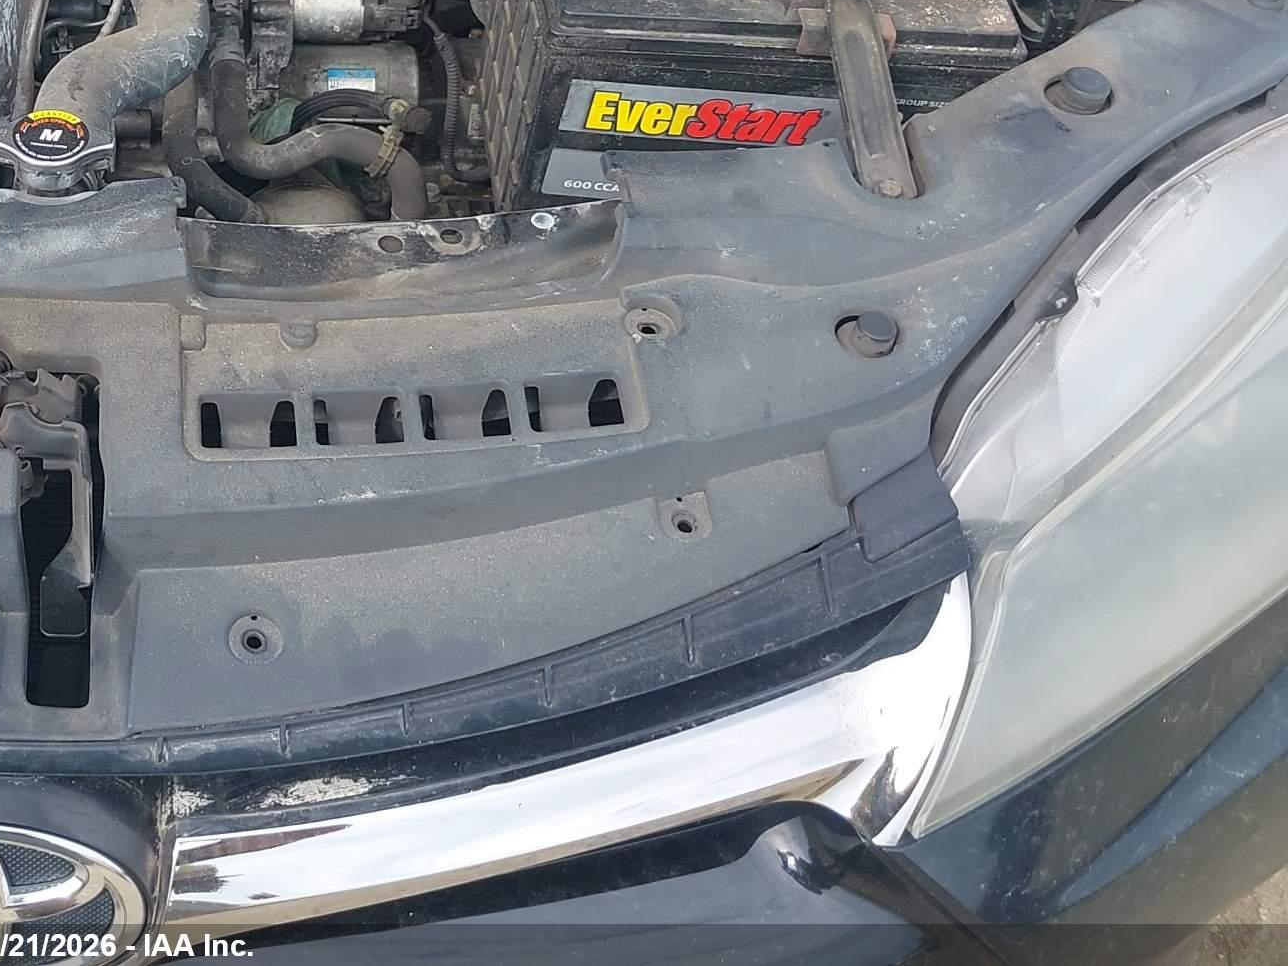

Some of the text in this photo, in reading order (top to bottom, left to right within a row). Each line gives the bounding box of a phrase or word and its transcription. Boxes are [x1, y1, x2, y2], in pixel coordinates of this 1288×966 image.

[585, 90, 824, 146] EverStart
[39, 128, 63, 142] M
[564, 179, 620, 193] 600 CCA
